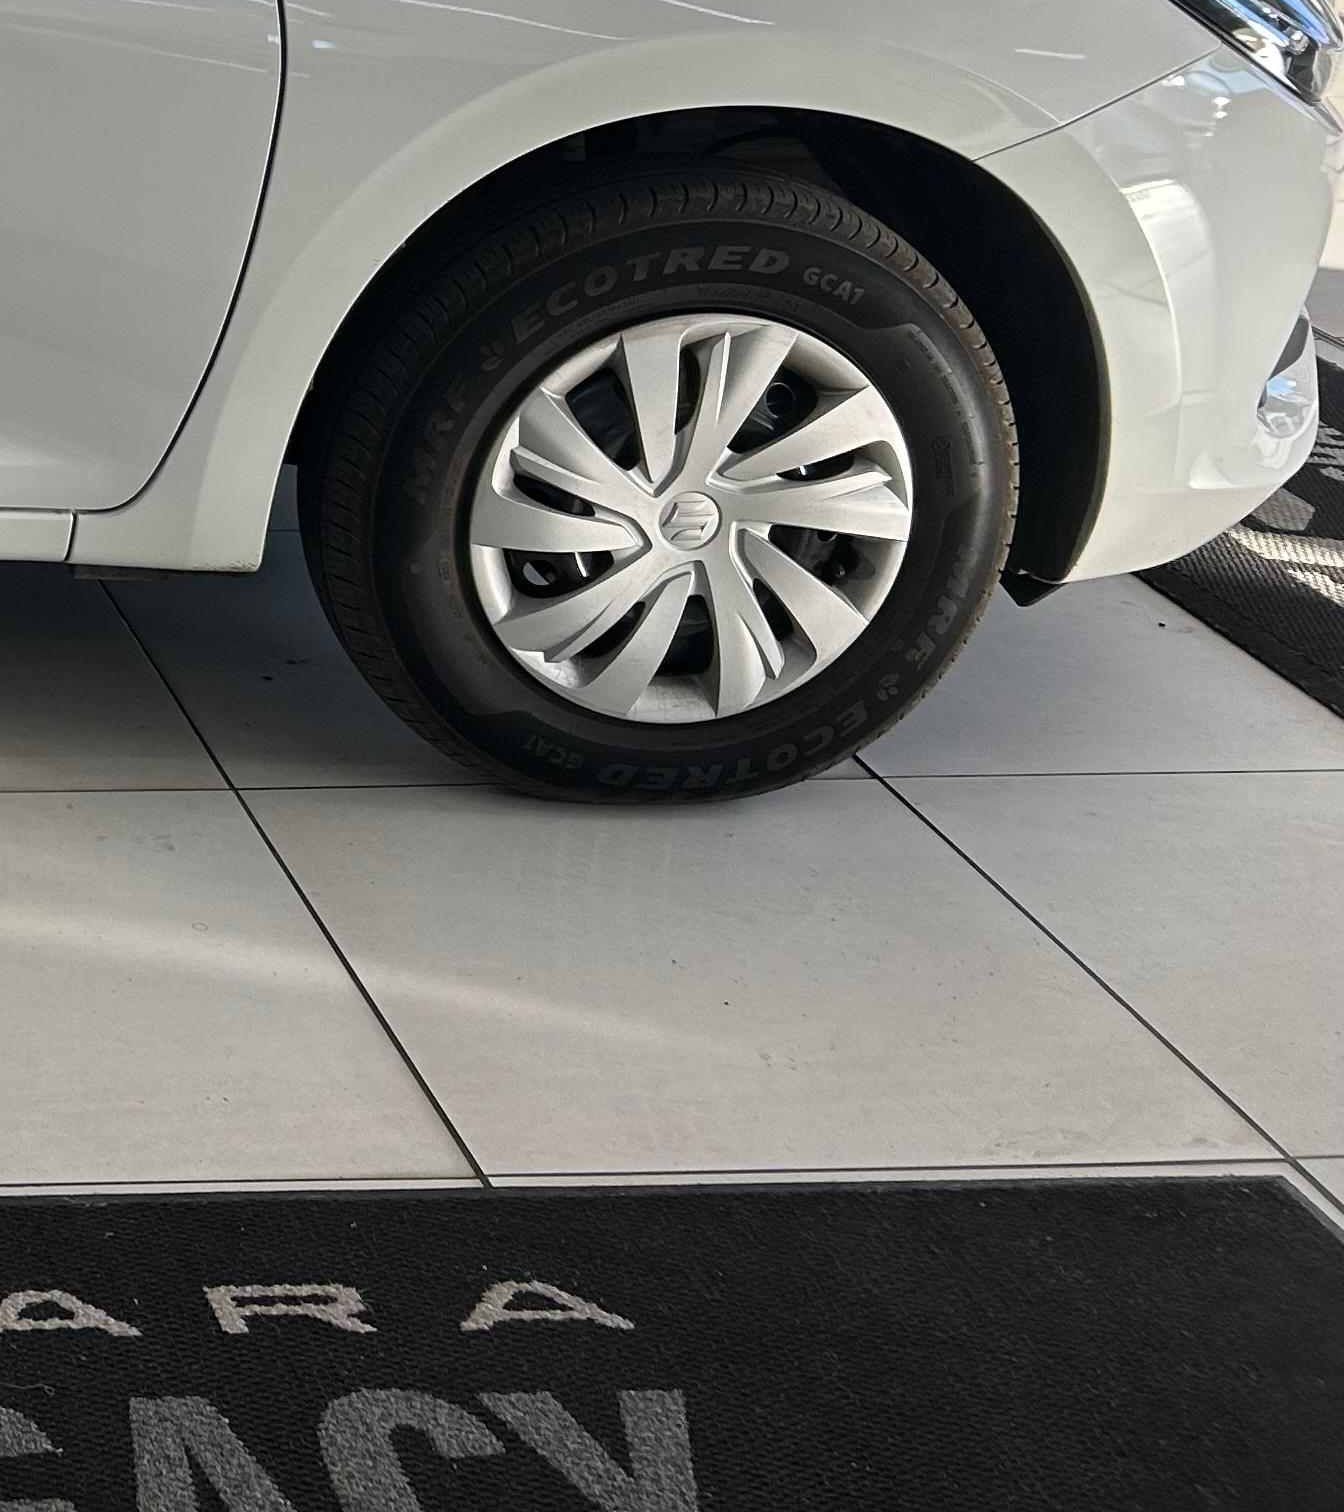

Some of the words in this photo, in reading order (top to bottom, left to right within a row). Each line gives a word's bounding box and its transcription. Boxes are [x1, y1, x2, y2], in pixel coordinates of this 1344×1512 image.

[513, 244, 792, 344] ECOTRED
[802, 266, 866, 305] GCA1
[595, 699, 870, 791] ECOTRED
